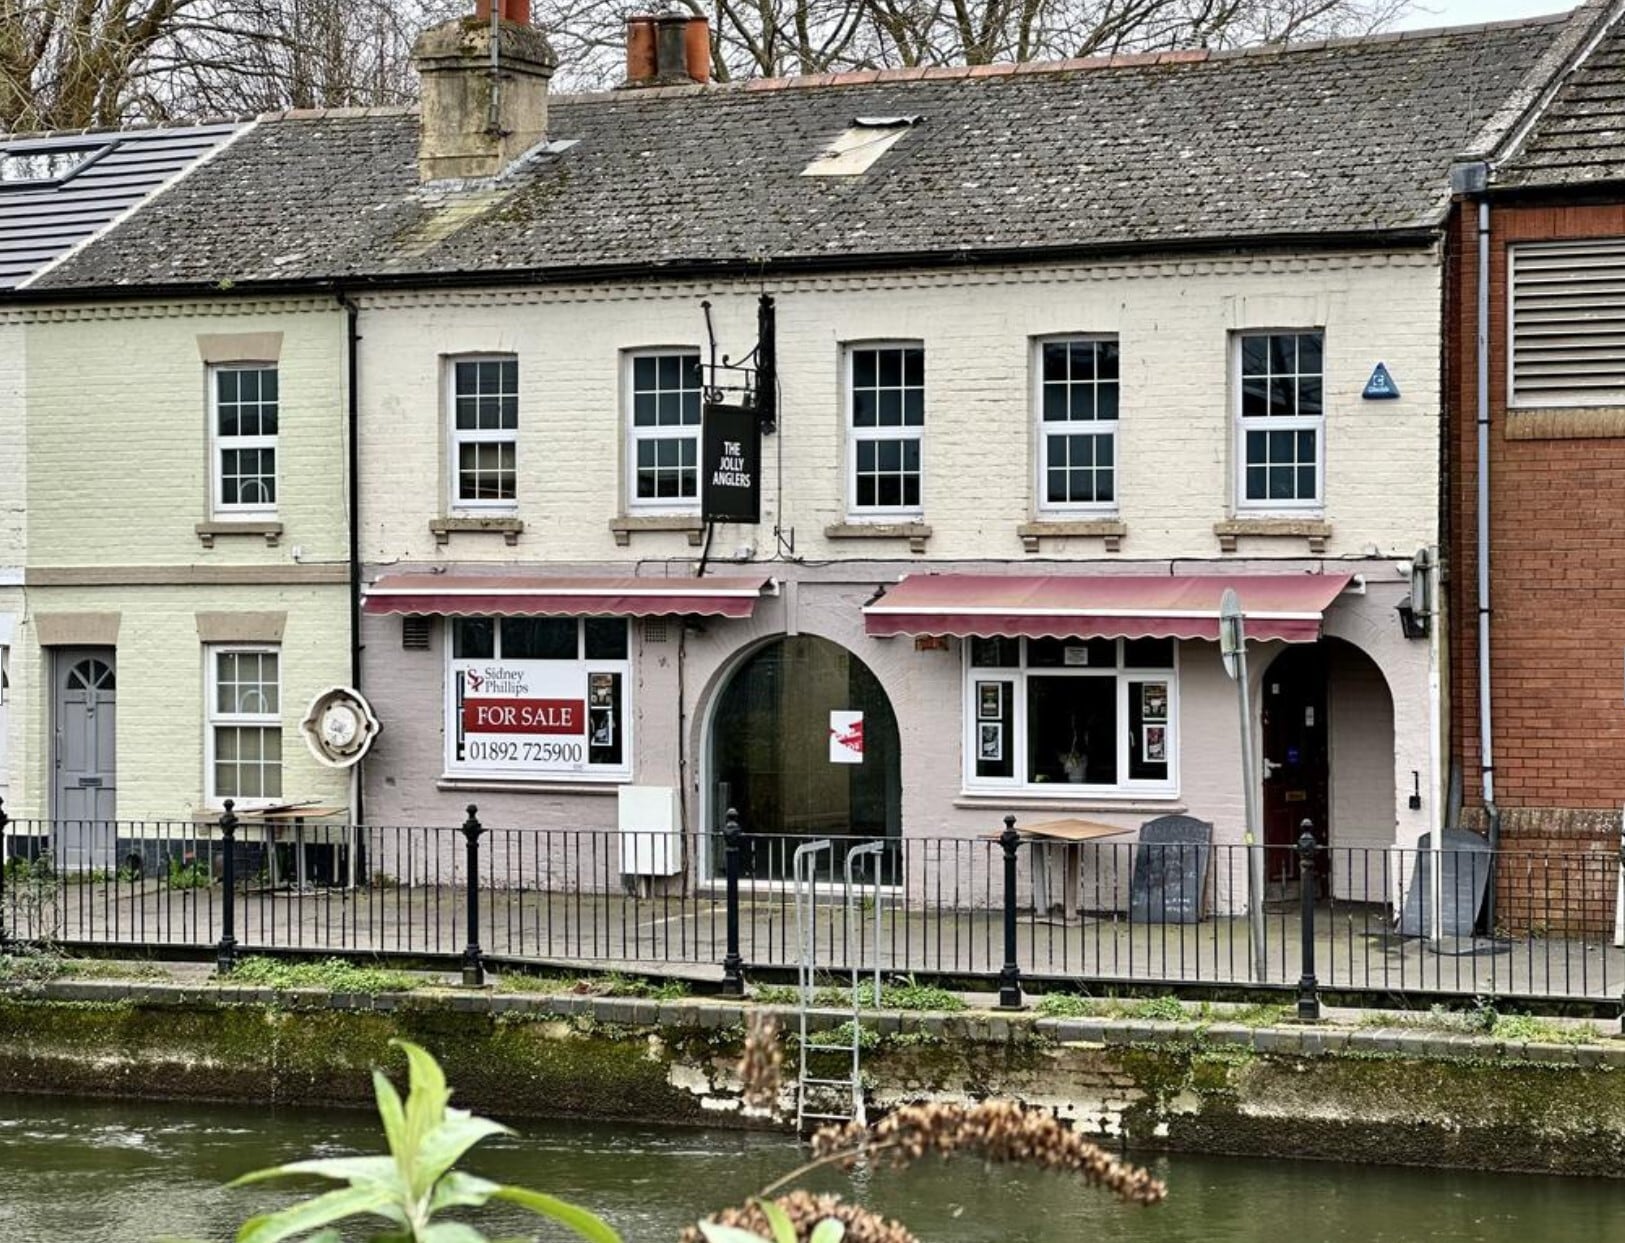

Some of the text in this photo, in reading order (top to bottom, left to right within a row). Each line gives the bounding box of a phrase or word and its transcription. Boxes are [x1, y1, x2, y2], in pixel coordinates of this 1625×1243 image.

[723, 441, 741, 456] THE
[719, 456, 744, 471] JOLLY
[712, 471, 751, 488] ANGLERS
[485, 667, 525, 680] Sidney
[485, 680, 529, 696] Phillips
[477, 706, 572, 727] FOR SALE
[470, 741, 582, 763] 01892 725900
